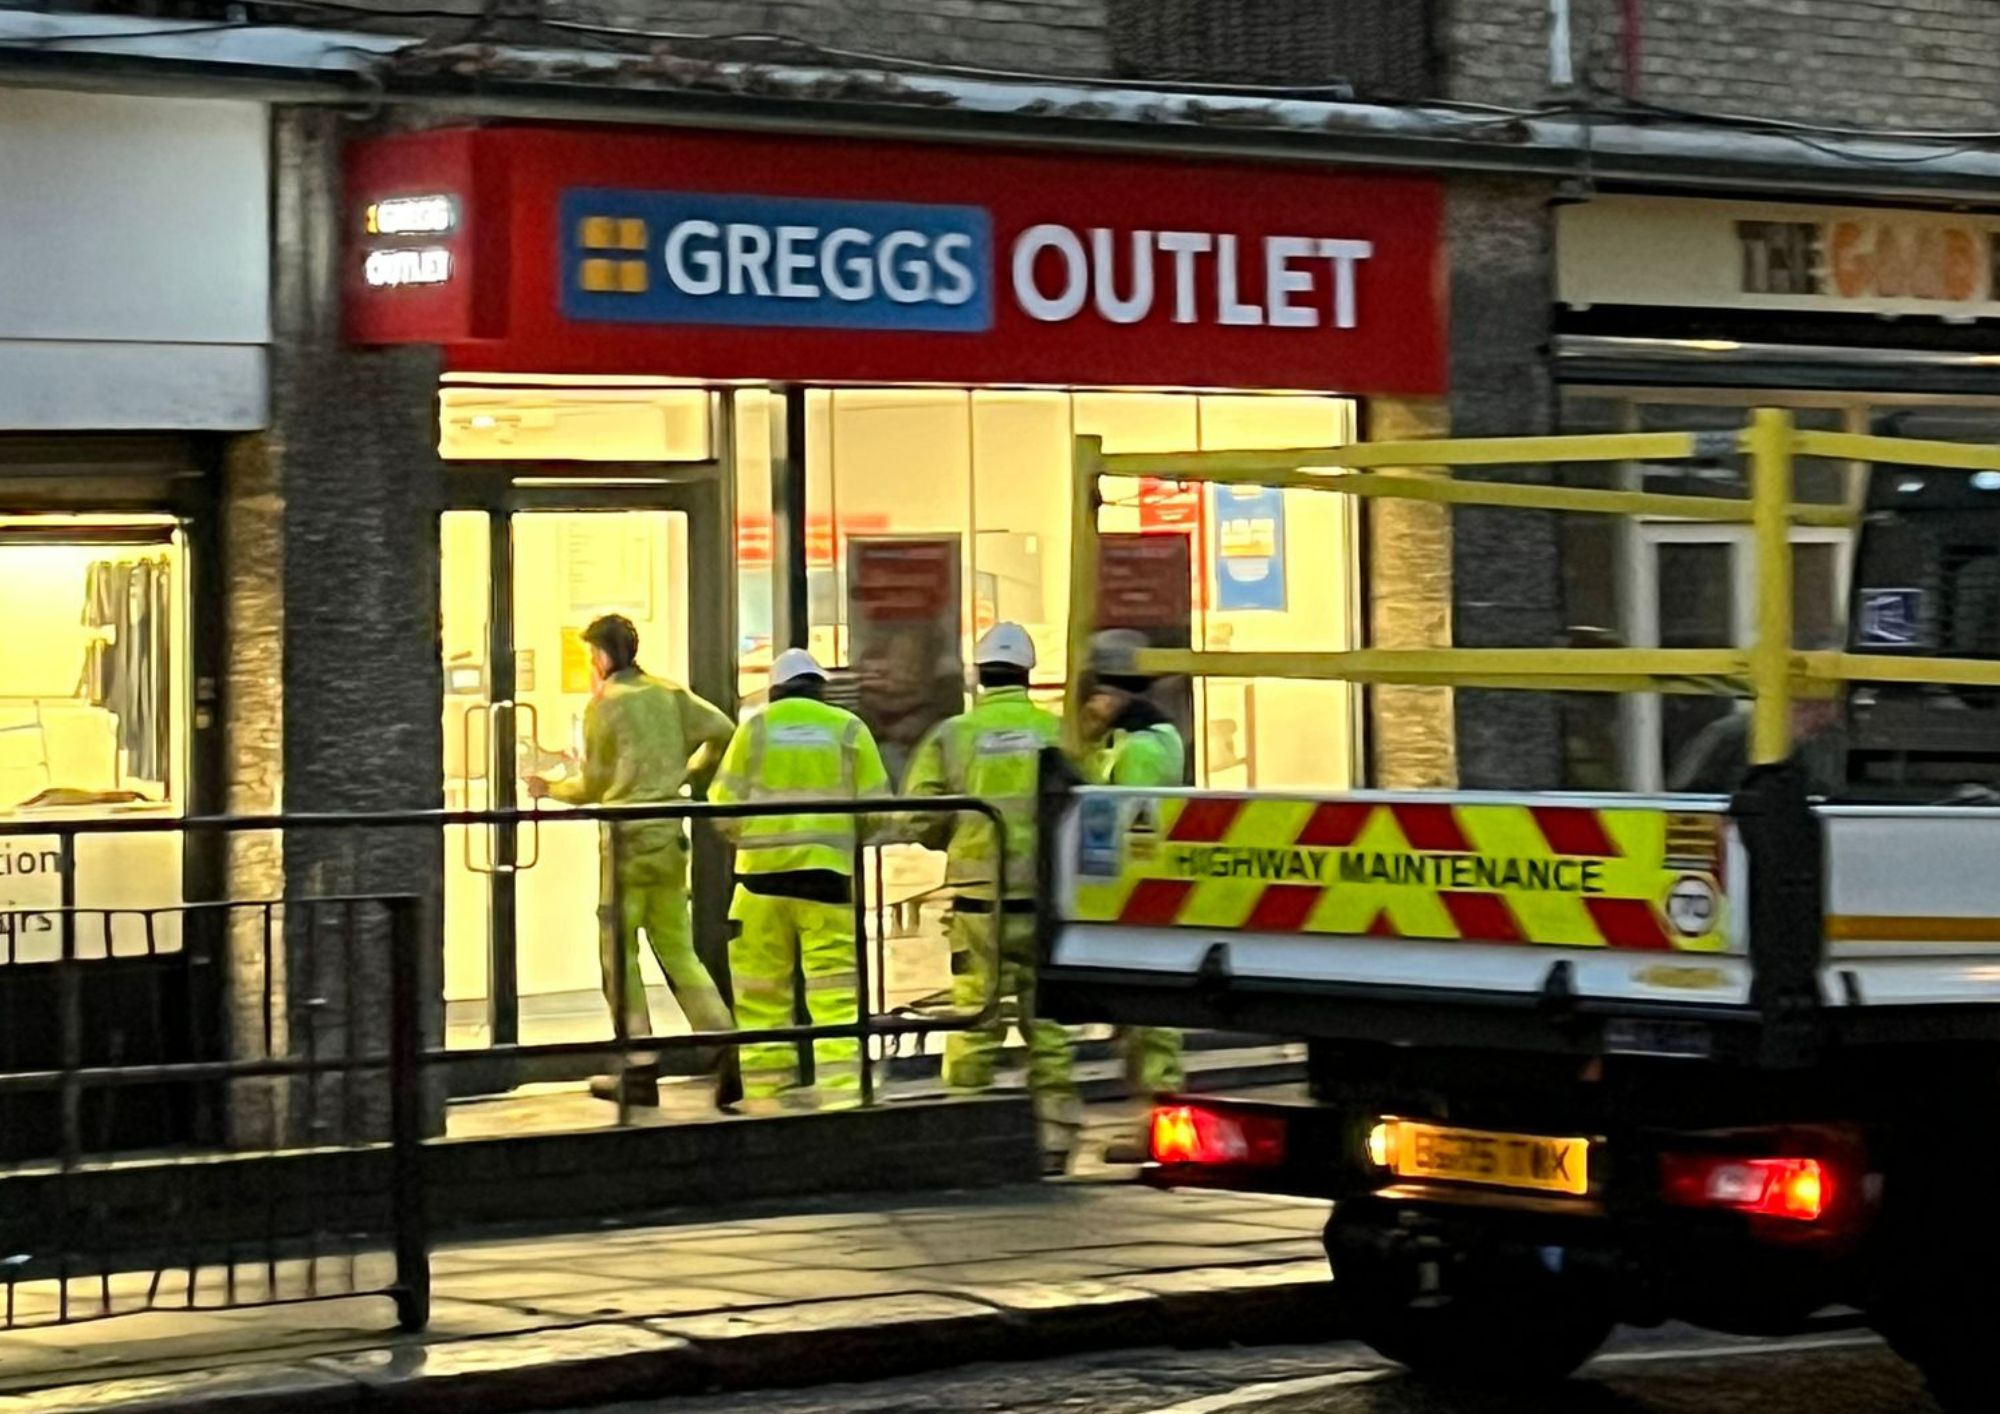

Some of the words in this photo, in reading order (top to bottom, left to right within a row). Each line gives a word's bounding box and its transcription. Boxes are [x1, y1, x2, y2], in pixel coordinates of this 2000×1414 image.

[664, 219, 976, 305] GREGGS
[1012, 223, 1373, 329] OUTLET
[1173, 846, 1326, 881] HIGHWAY
[1339, 850, 1606, 894] MAINTENANCE
